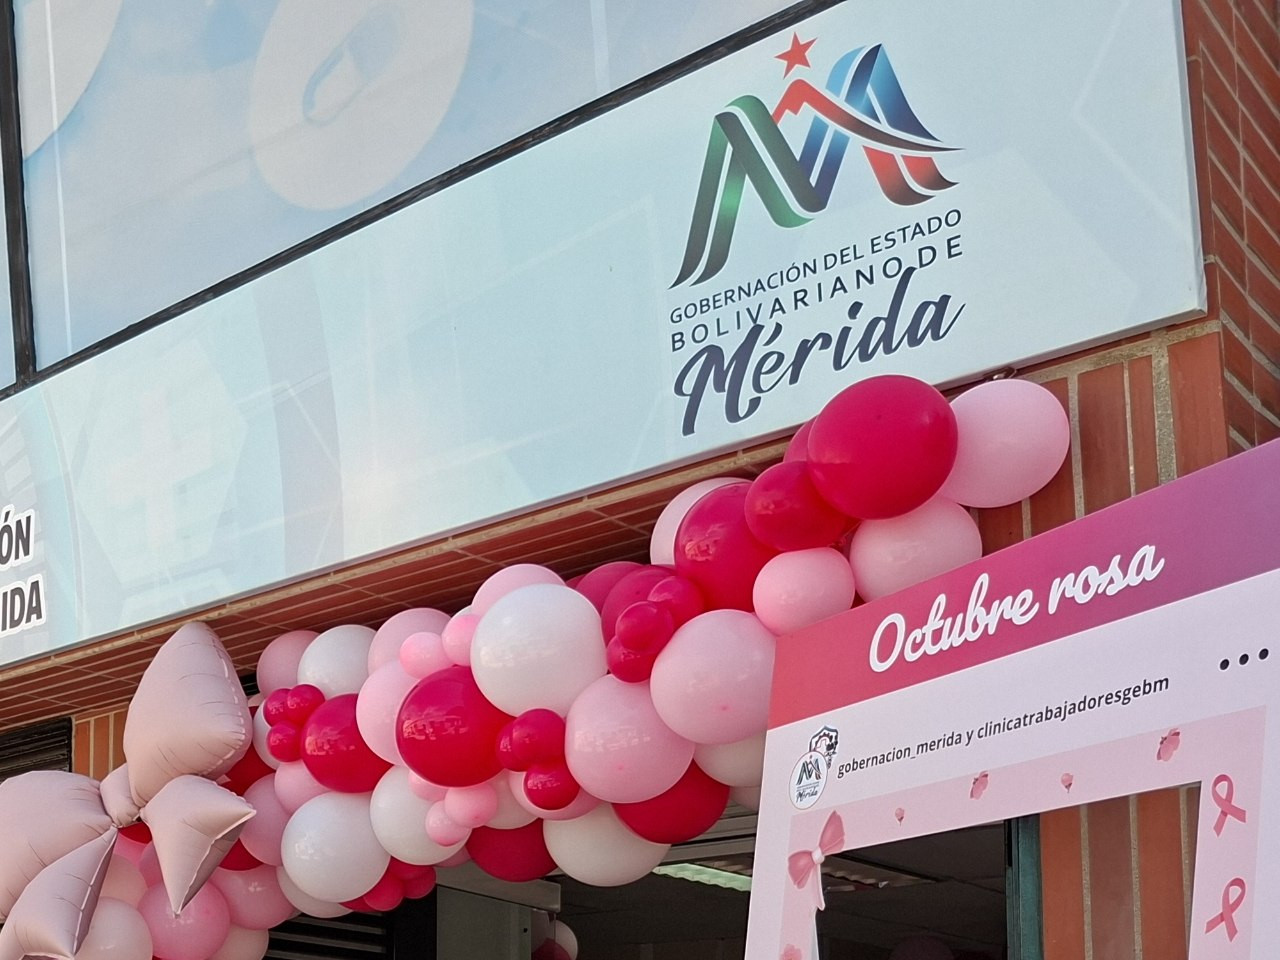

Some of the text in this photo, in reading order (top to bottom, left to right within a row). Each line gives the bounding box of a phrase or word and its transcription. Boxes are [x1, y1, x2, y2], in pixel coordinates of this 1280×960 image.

[670, 209, 961, 324] GOBERNACIÓN DEL ESTADO
[671, 235, 963, 352] BOLIVARIANO DE
[673, 266, 966, 436] Mérida
[869, 544, 1165, 673] Octubre rosa
[837, 677, 1169, 778] gobernacion_merida y clinicatrabajadoresgebm
